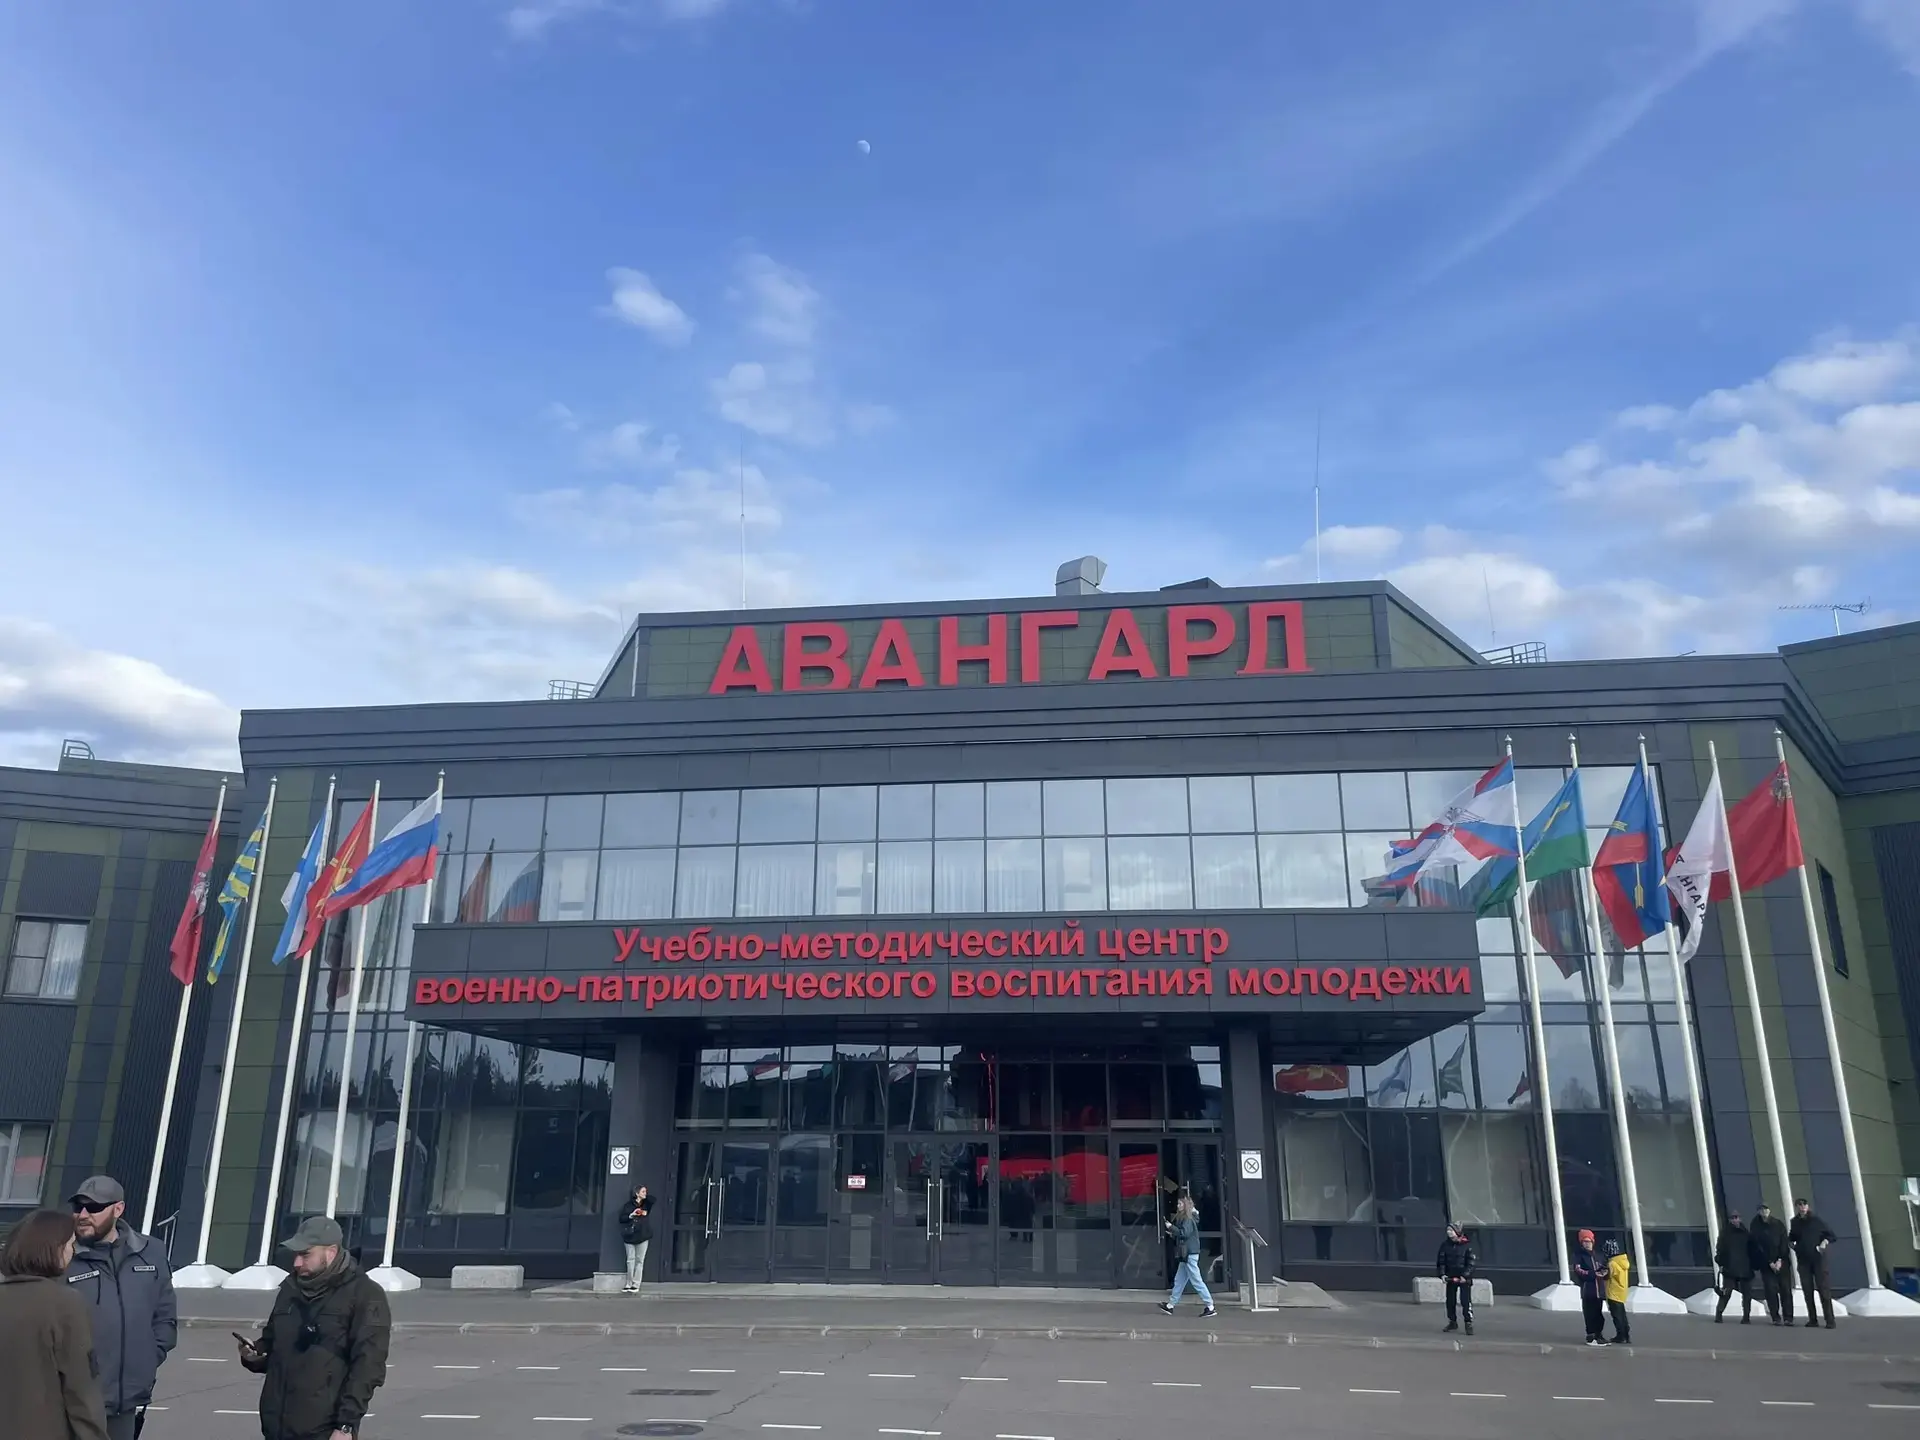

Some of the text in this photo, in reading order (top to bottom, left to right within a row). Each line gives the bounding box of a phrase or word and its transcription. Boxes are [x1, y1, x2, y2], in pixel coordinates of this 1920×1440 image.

[709, 601, 1312, 695] АВАНГАРД
[613, 920, 1229, 966] Учебно-методический центр
[415, 966, 1472, 1009] военно-патриотического воспитания молодежи
